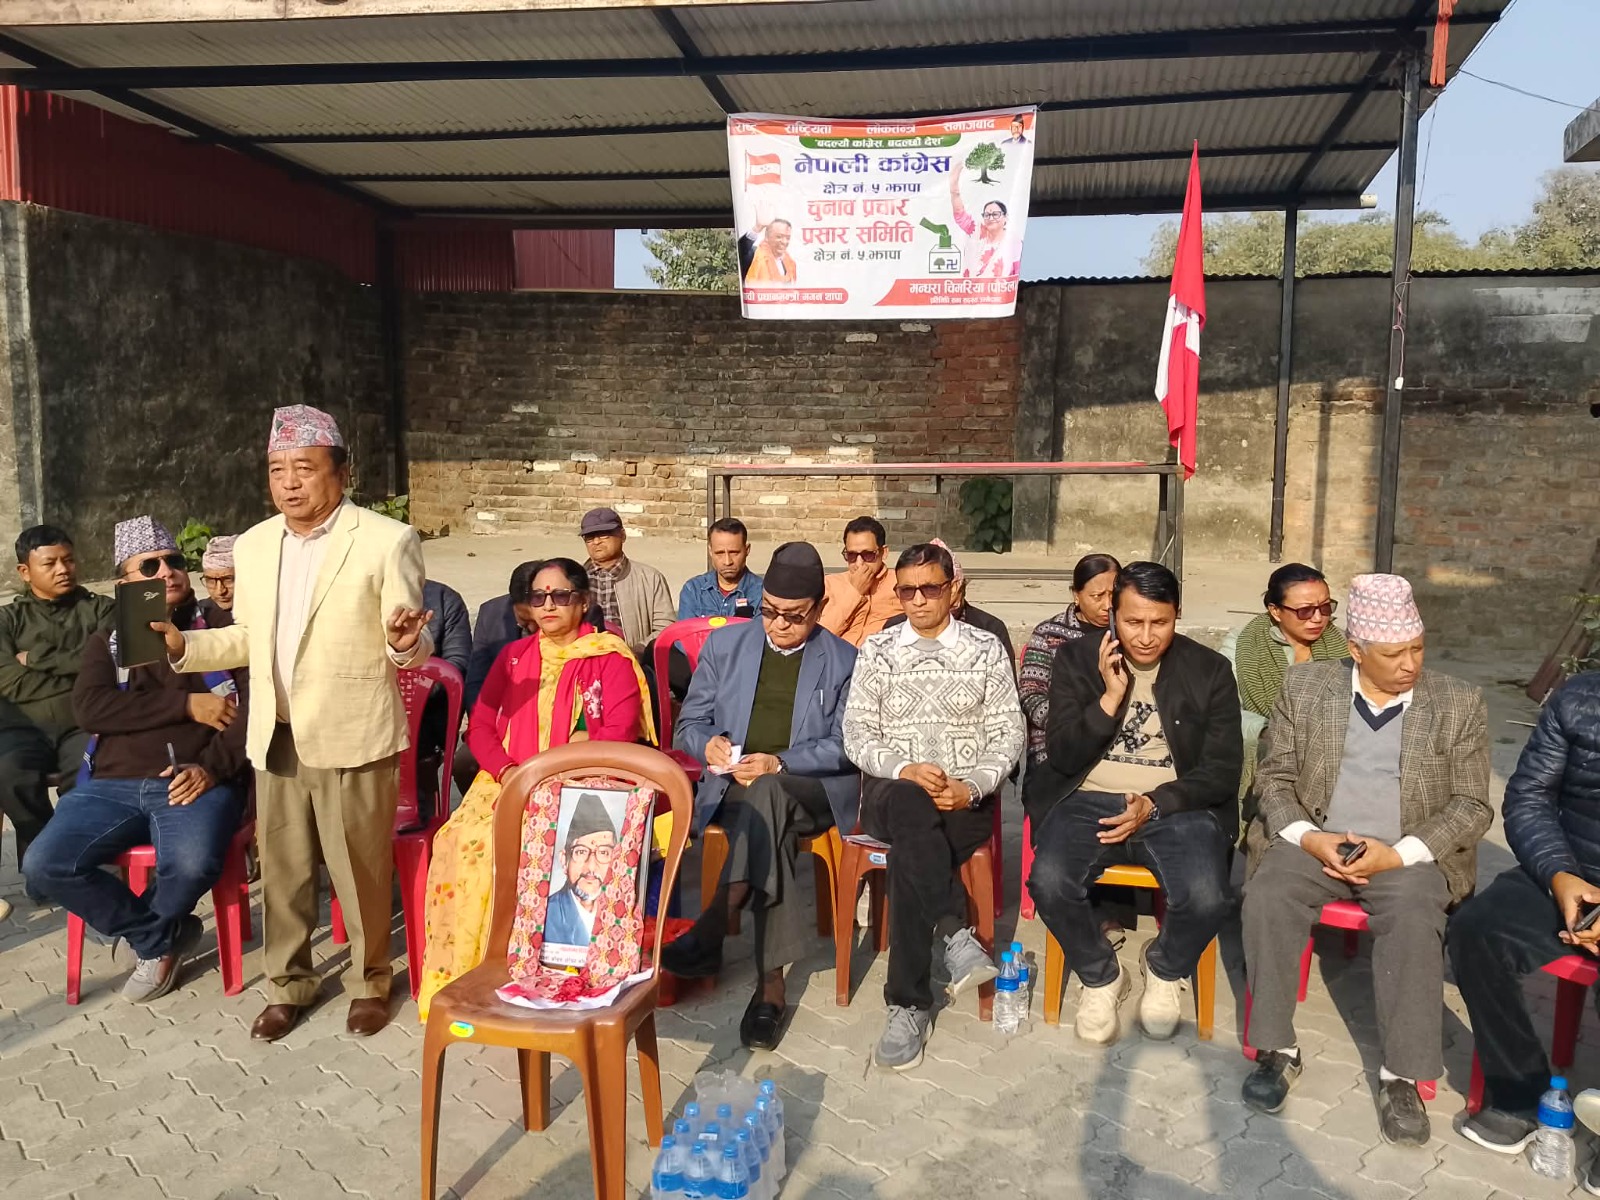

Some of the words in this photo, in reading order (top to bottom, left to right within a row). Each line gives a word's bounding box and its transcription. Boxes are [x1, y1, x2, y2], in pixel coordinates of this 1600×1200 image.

[794, 152, 870, 174] नेपाली
[878, 151, 952, 174] काँग्रेस
[823, 181, 847, 195] क्षेत्र
[885, 182, 921, 193] झापा
[807, 199, 856, 222] चुनाव
[862, 199, 910, 217] प्रचार
[801, 227, 850, 245] प्रसार
[856, 220, 915, 244] समिति
[813, 248, 835, 261] क्षेत्र
